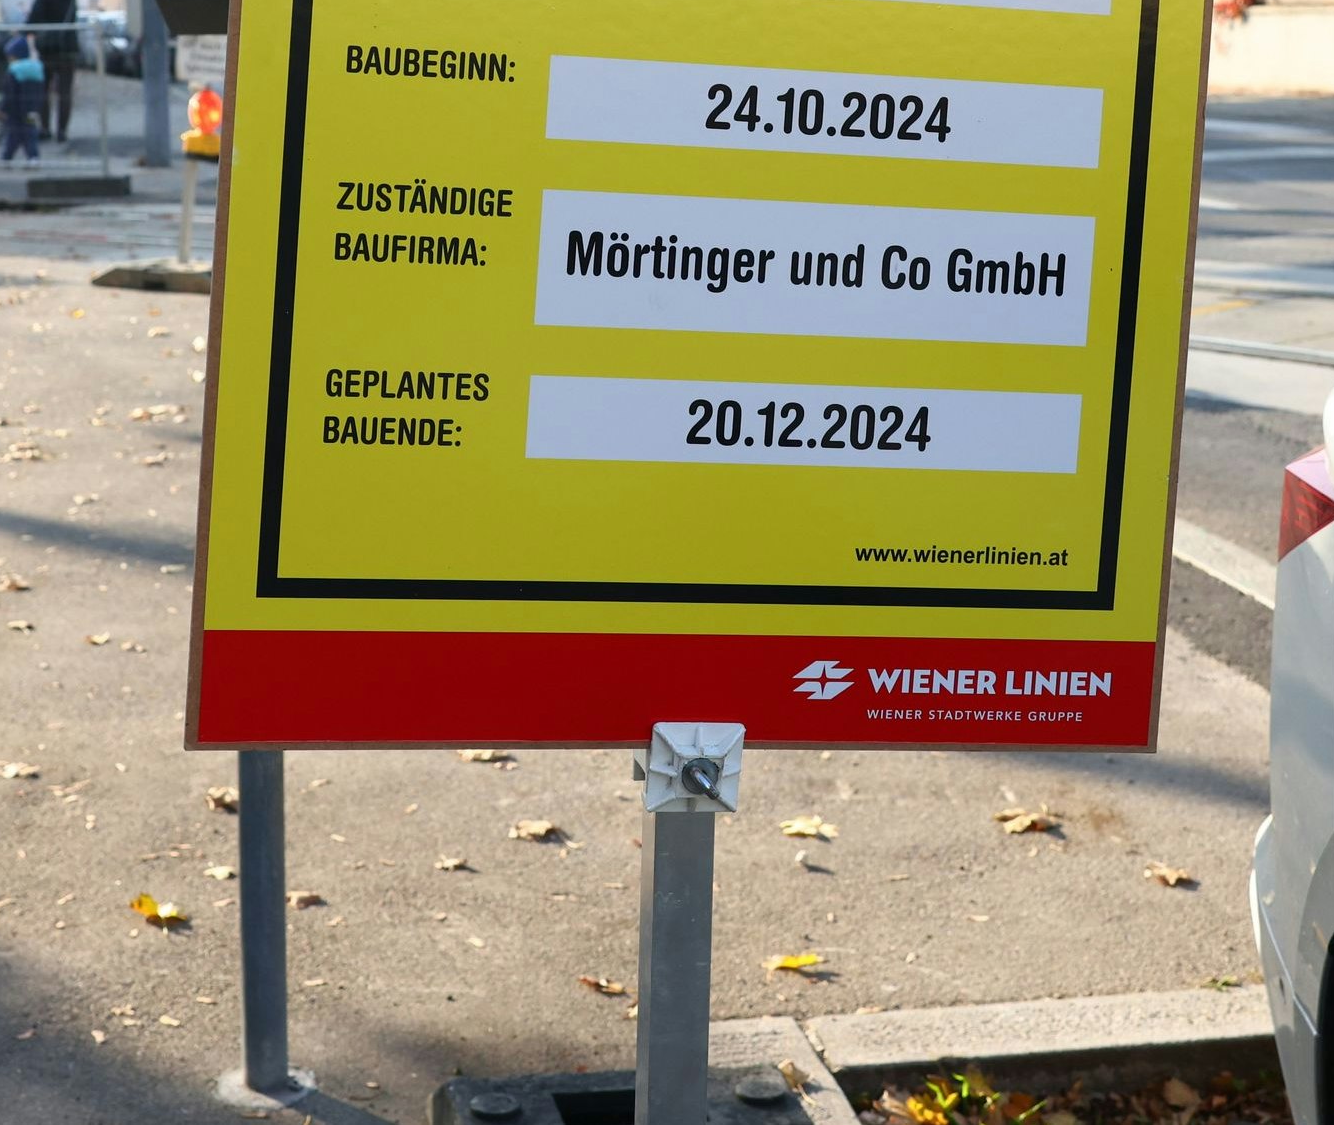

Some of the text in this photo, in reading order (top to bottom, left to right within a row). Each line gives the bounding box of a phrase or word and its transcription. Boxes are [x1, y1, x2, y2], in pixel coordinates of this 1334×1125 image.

[345, 45, 516, 83] BAUBEGINN:
[705, 83, 952, 143] 24.10.2024
[336, 178, 514, 218] ZUSTÄNDIGE
[334, 232, 487, 267] BAUFIRMA:
[566, 230, 1066, 297] Mörtinger und Co GmbH
[325, 368, 490, 402] GEPLANTES
[322, 415, 462, 447] BAUENDE:
[685, 398, 932, 452] 20.12.2024
[855, 546, 1069, 567] www.wienerlinien.at
[868, 669, 1112, 697] WIENER LINIEN
[866, 709, 1083, 722] WIENER STADTWERKE GRUPPE
